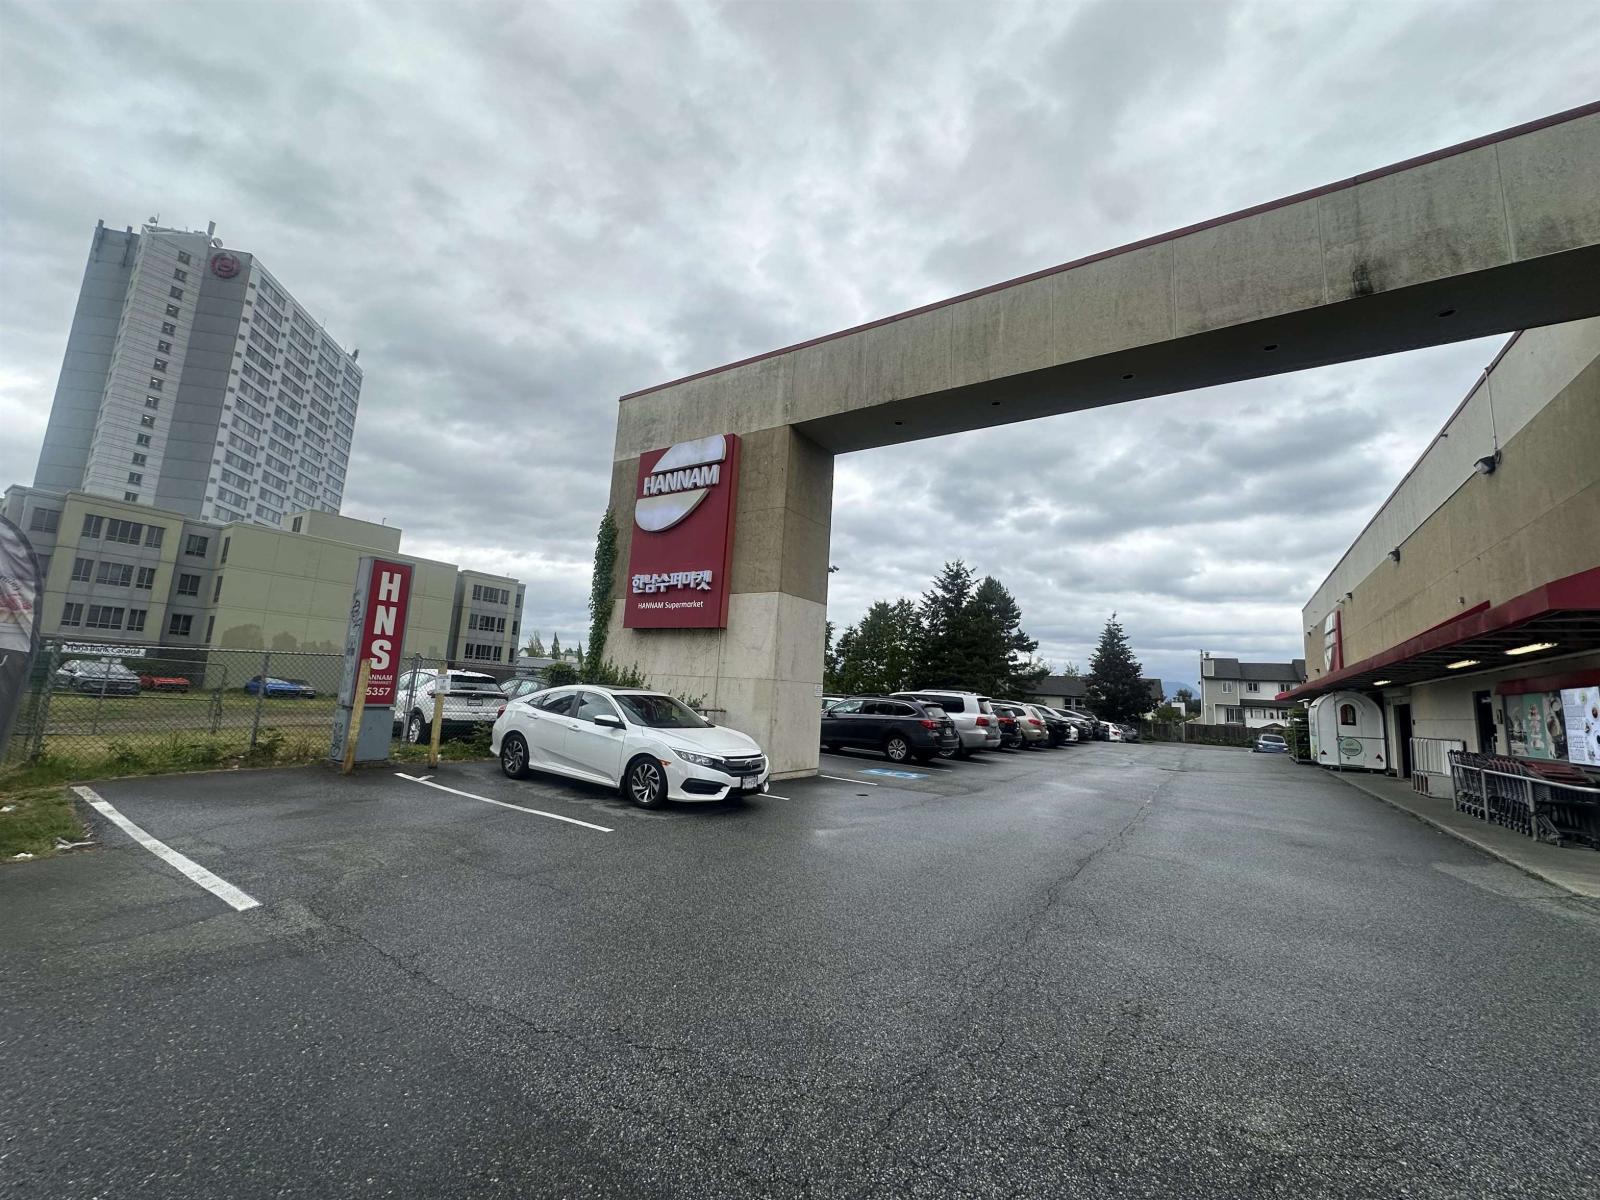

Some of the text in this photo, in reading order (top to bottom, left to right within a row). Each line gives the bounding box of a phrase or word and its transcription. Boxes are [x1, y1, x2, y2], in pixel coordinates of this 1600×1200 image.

[643, 464, 720, 496] HANNAM
[632, 569, 713, 594] 한남수퍼마켓
[637, 600, 704, 610] HANNAM Supermarket
